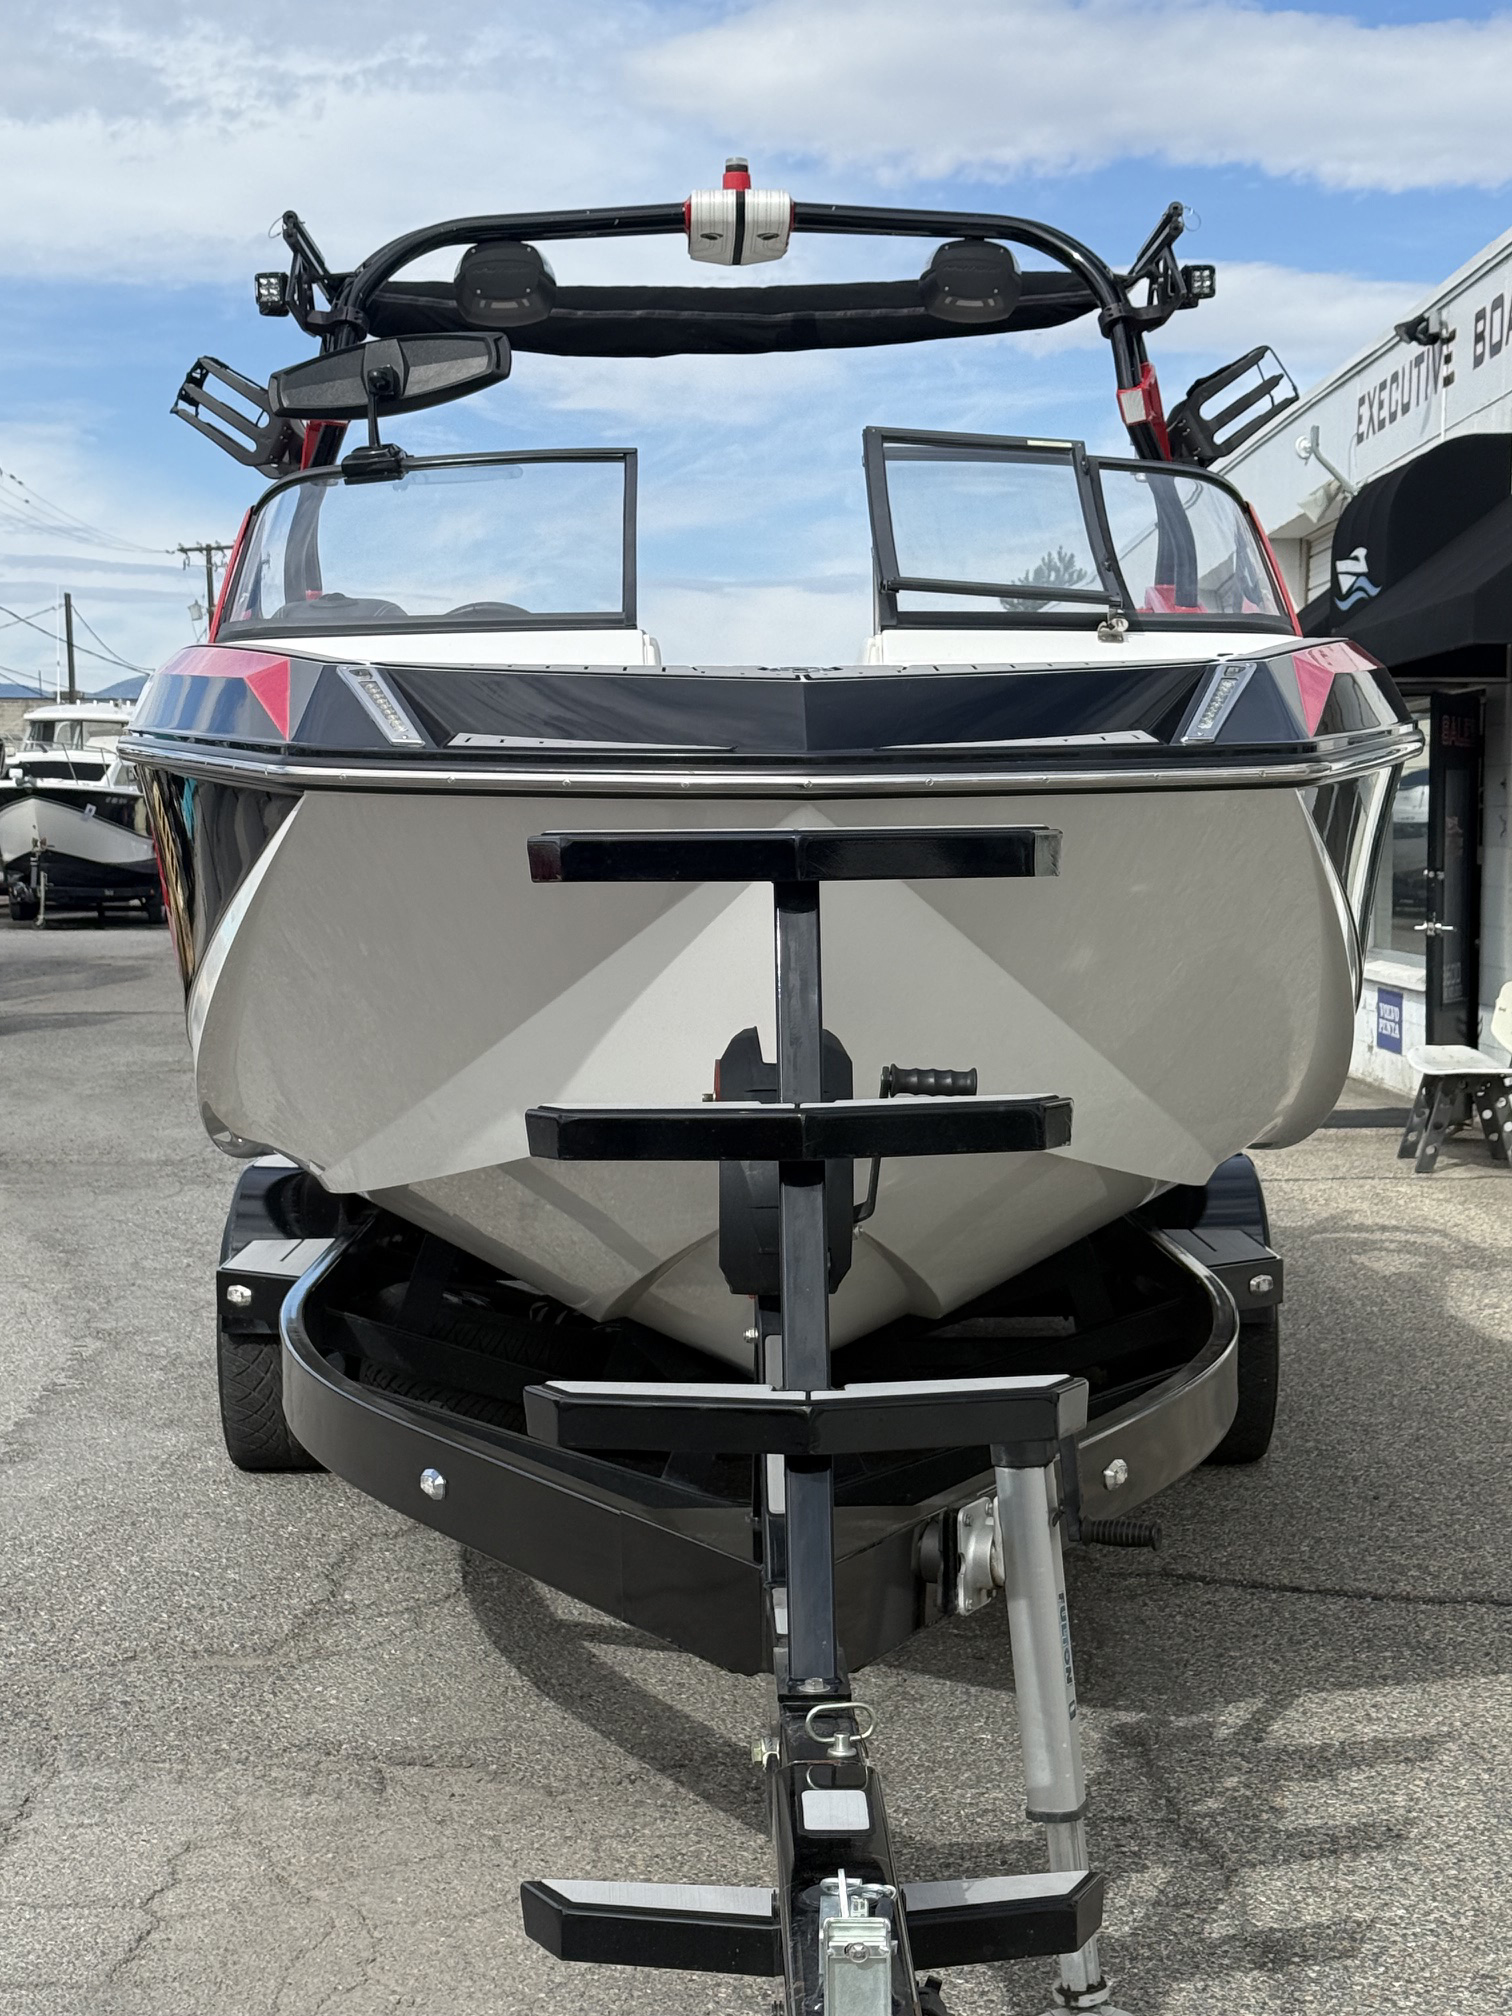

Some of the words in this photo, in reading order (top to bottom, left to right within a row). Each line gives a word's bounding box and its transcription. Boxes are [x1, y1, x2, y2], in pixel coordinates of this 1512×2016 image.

[1356, 328, 1457, 446] EXECUTIVE
[1378, 1002, 1400, 1022] VOLVO
[1378, 1017, 1400, 1039] PENTA
[1059, 1592, 1073, 1685] FULTON
